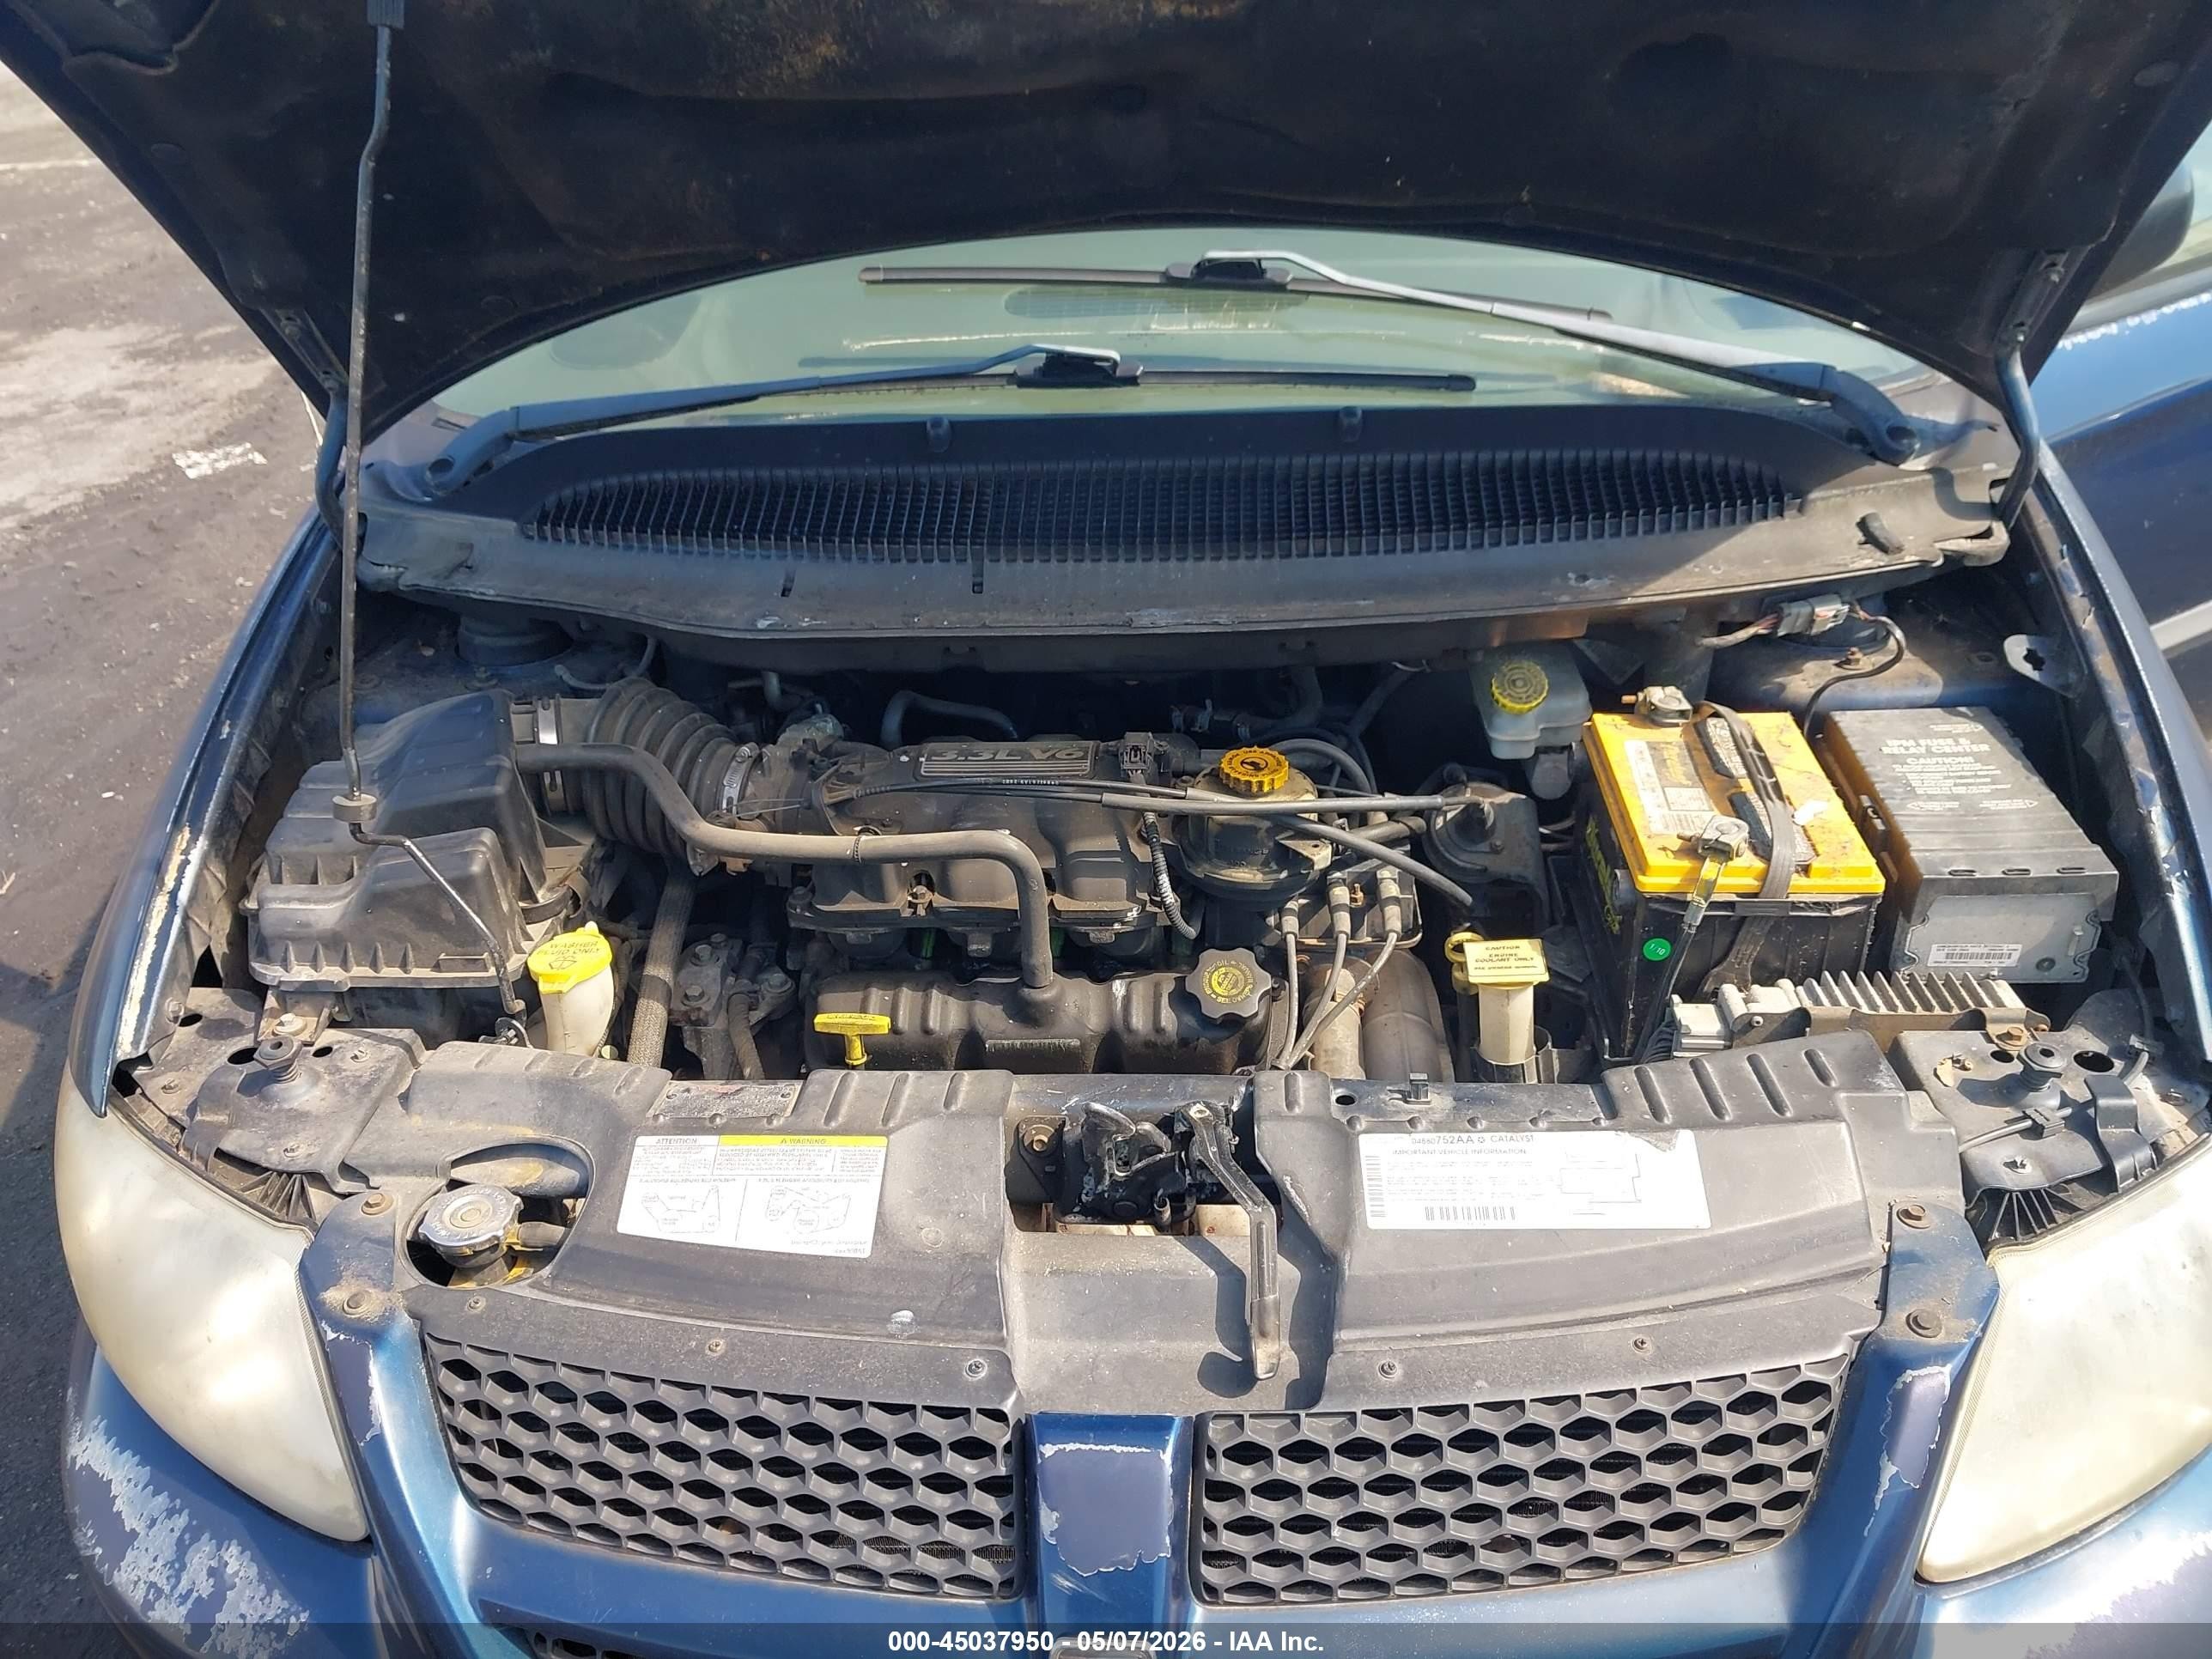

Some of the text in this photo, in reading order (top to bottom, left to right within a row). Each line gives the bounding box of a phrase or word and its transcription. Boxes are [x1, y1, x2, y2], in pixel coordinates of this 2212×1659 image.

[1931, 744, 1990, 752] CENTER
[932, 749, 1085, 761] 3.3L V6
[1490, 1134, 1534, 1144] CATALYST
